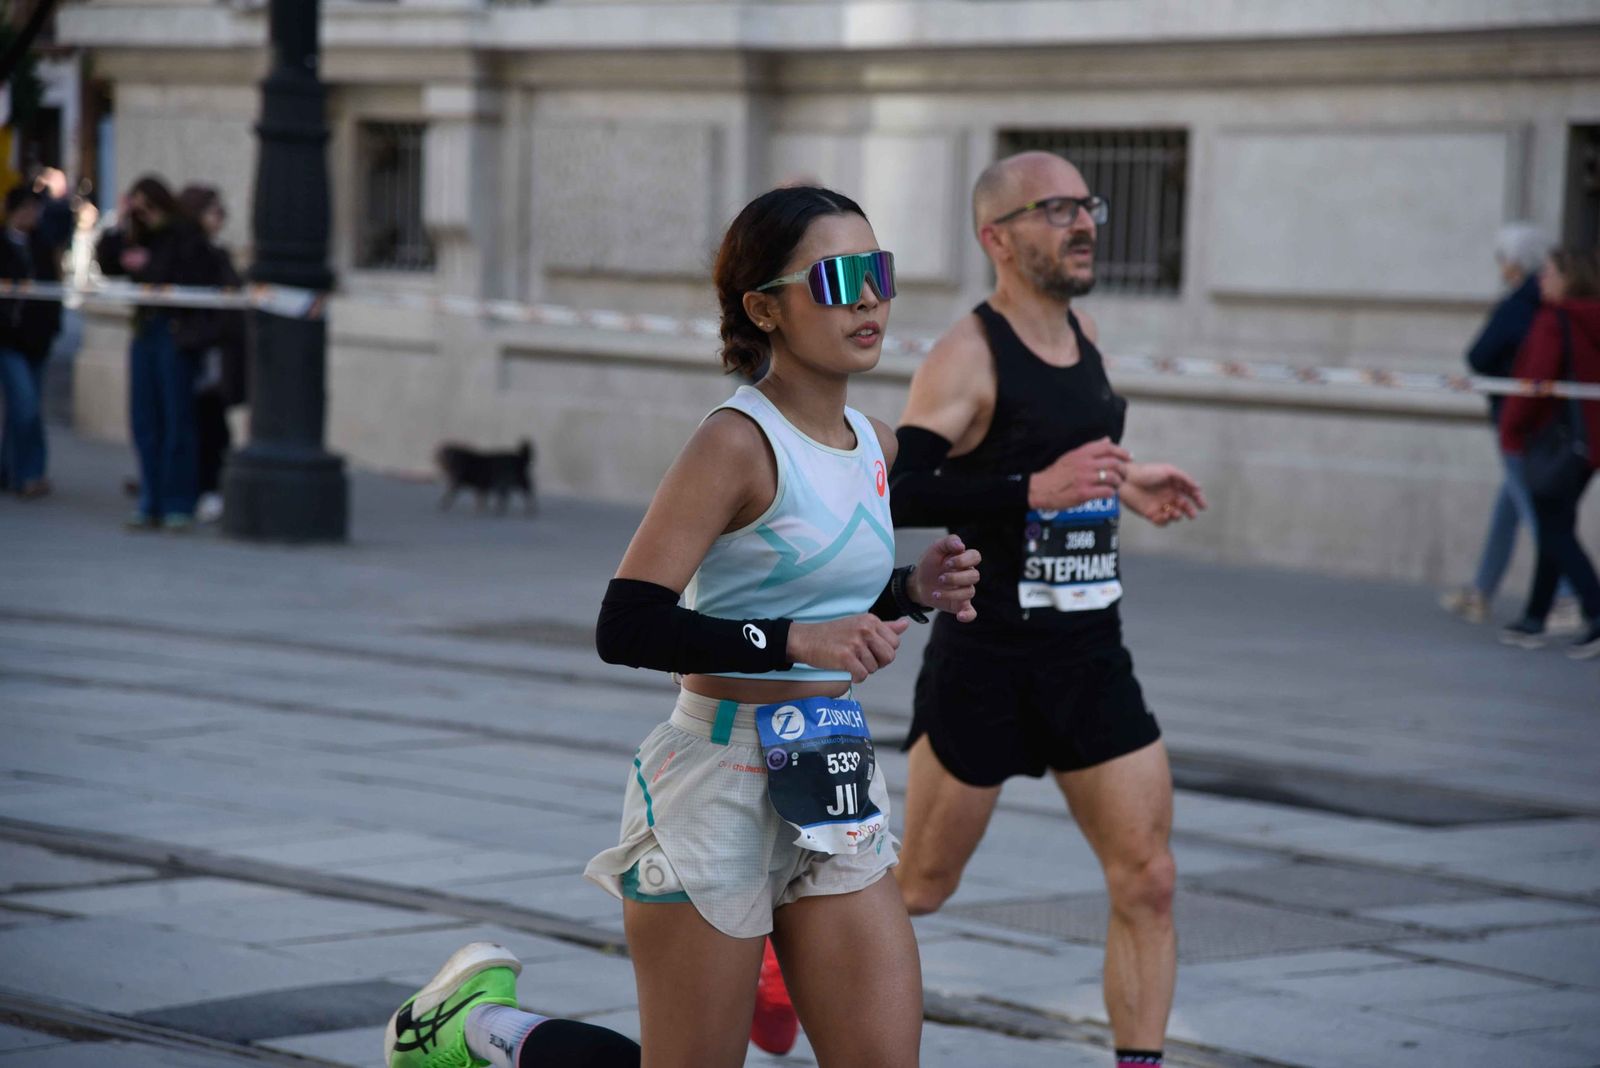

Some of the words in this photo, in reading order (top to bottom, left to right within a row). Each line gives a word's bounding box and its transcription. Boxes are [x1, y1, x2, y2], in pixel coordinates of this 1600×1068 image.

[1024, 553, 1117, 582] STEPHANE
[816, 708, 864, 728] ZURICH
[826, 782, 858, 816] JI
